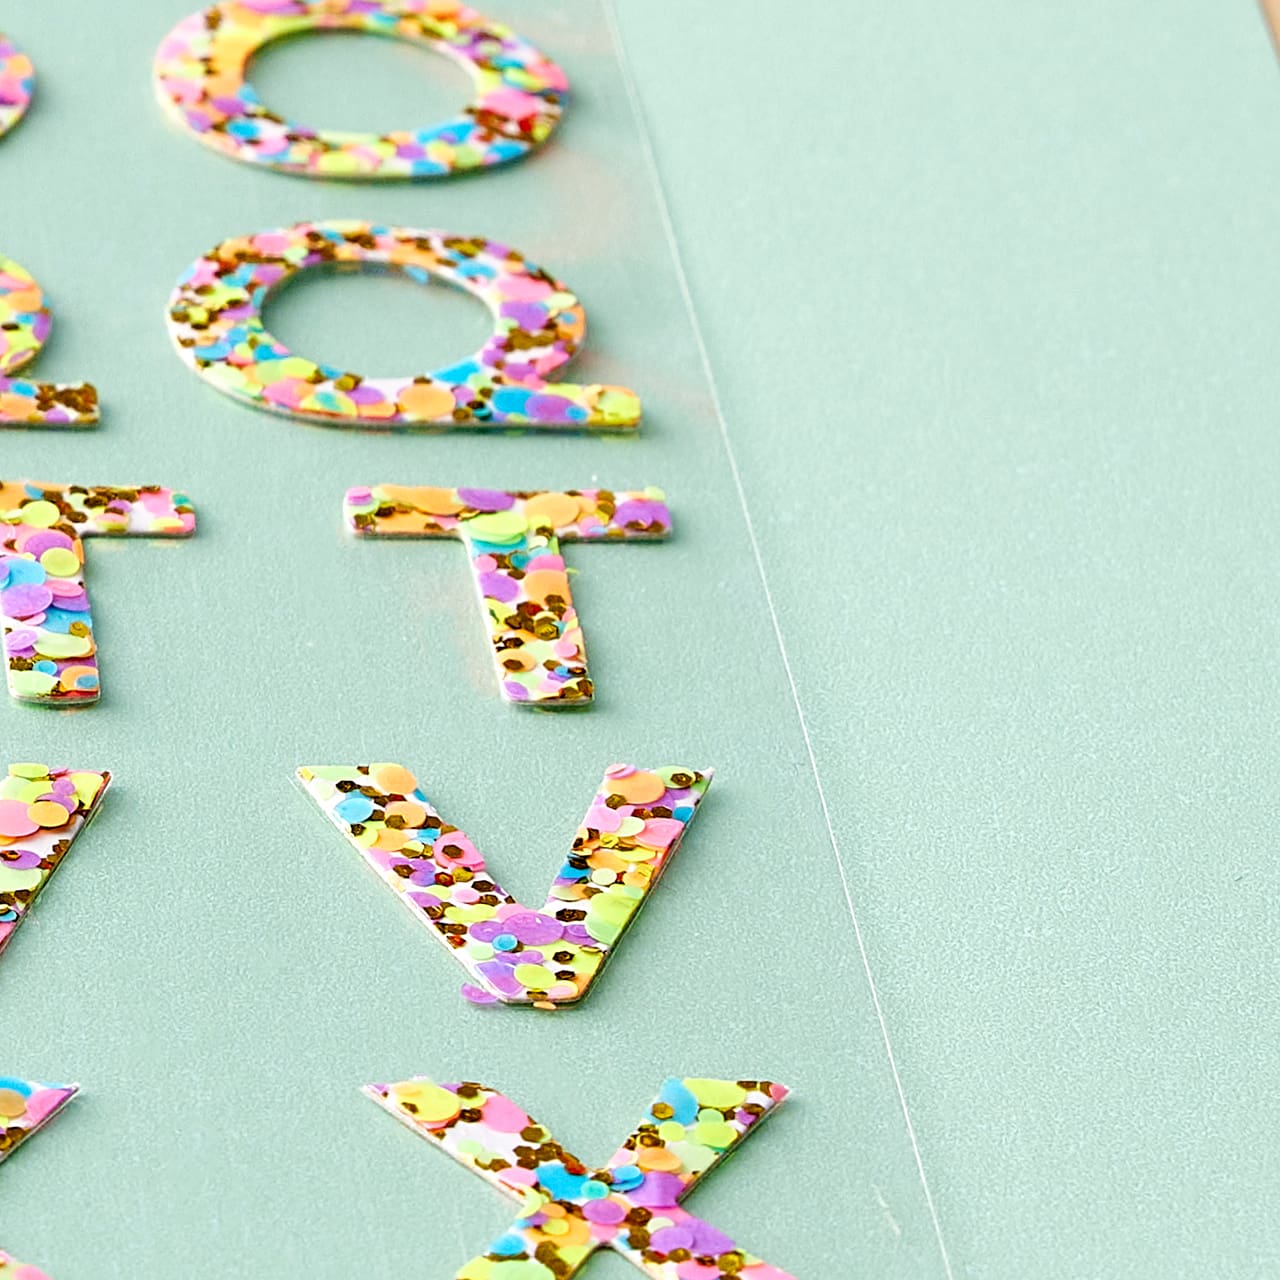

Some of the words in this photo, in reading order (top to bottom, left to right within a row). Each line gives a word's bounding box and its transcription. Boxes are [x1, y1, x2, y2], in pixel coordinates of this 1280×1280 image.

[167, 220, 643, 433] Q
[343, 484, 674, 707] T
[293, 762, 714, 1008] V
